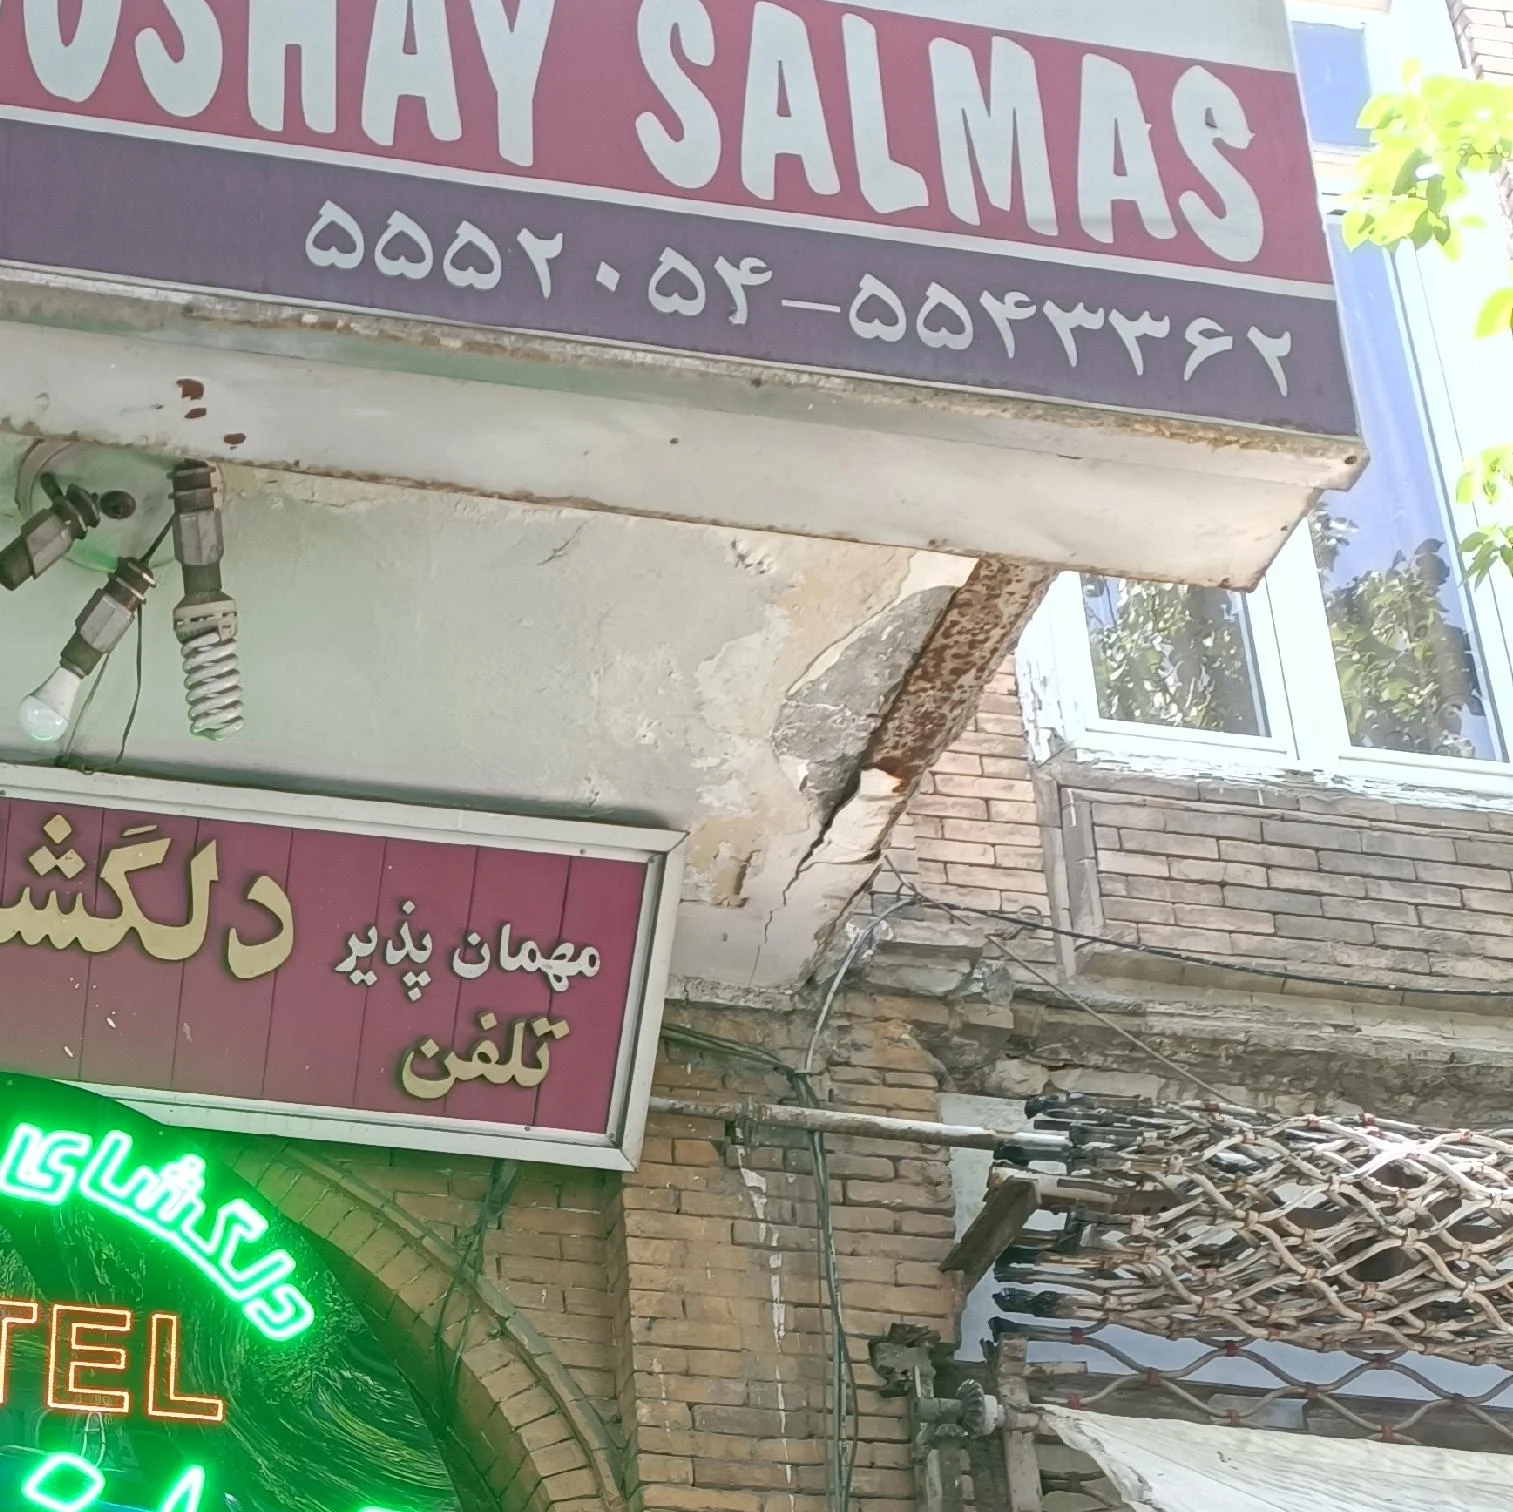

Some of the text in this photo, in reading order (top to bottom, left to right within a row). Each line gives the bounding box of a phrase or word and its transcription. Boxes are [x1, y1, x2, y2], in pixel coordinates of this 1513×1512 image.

[635, 0, 1255, 263] SALMAS
[334, 900, 433, 1000] پذیر
[452, 922, 601, 991] مهمان
[402, 1012, 570, 1100] تلفن
